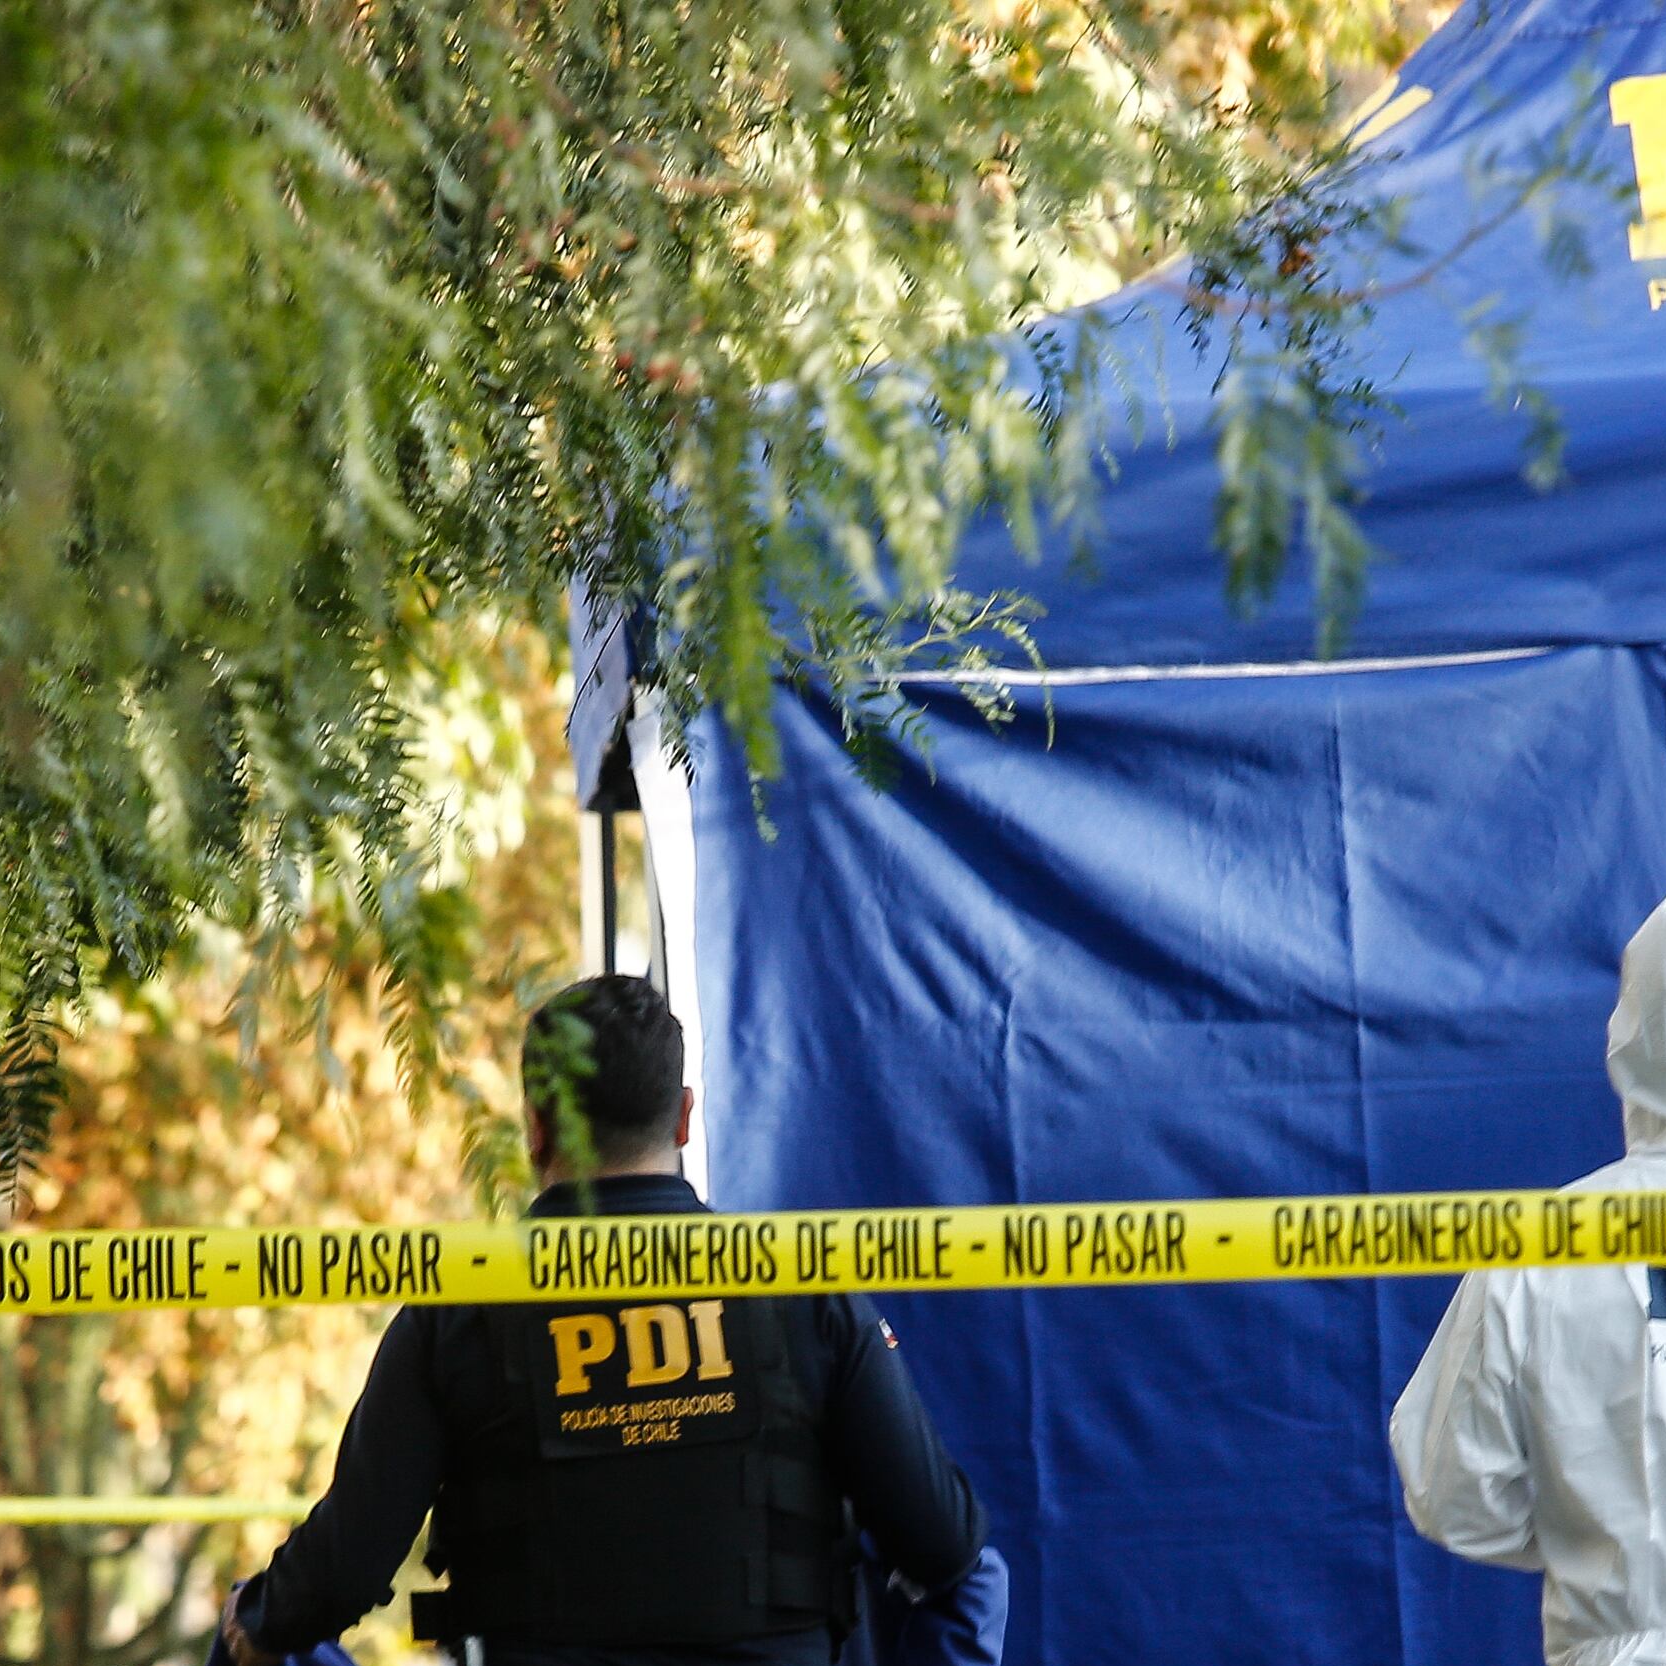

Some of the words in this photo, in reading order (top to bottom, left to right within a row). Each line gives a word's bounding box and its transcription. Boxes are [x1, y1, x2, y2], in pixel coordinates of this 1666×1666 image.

[50, 1237, 93, 1303] DE
[108, 1235, 208, 1301] CHILE
[258, 1232, 304, 1299] NO
[321, 1231, 443, 1298] PASAR
[530, 1218, 778, 1290] CARABINEROS
[798, 1218, 840, 1284] DE
[854, 1215, 955, 1282] CHILE
[1002, 1212, 1046, 1278] NO
[1066, 1210, 1188, 1278] PASAR
[1273, 1199, 1523, 1268] CARABINEROS
[1542, 1196, 1586, 1258] DE
[547, 1300, 734, 1397] PDI
[610, 1403, 629, 1426] DE
[630, 1391, 736, 1422] INVESTIGACIONES
[622, 1424, 642, 1446] DE
[642, 1419, 683, 1443] CHILE
